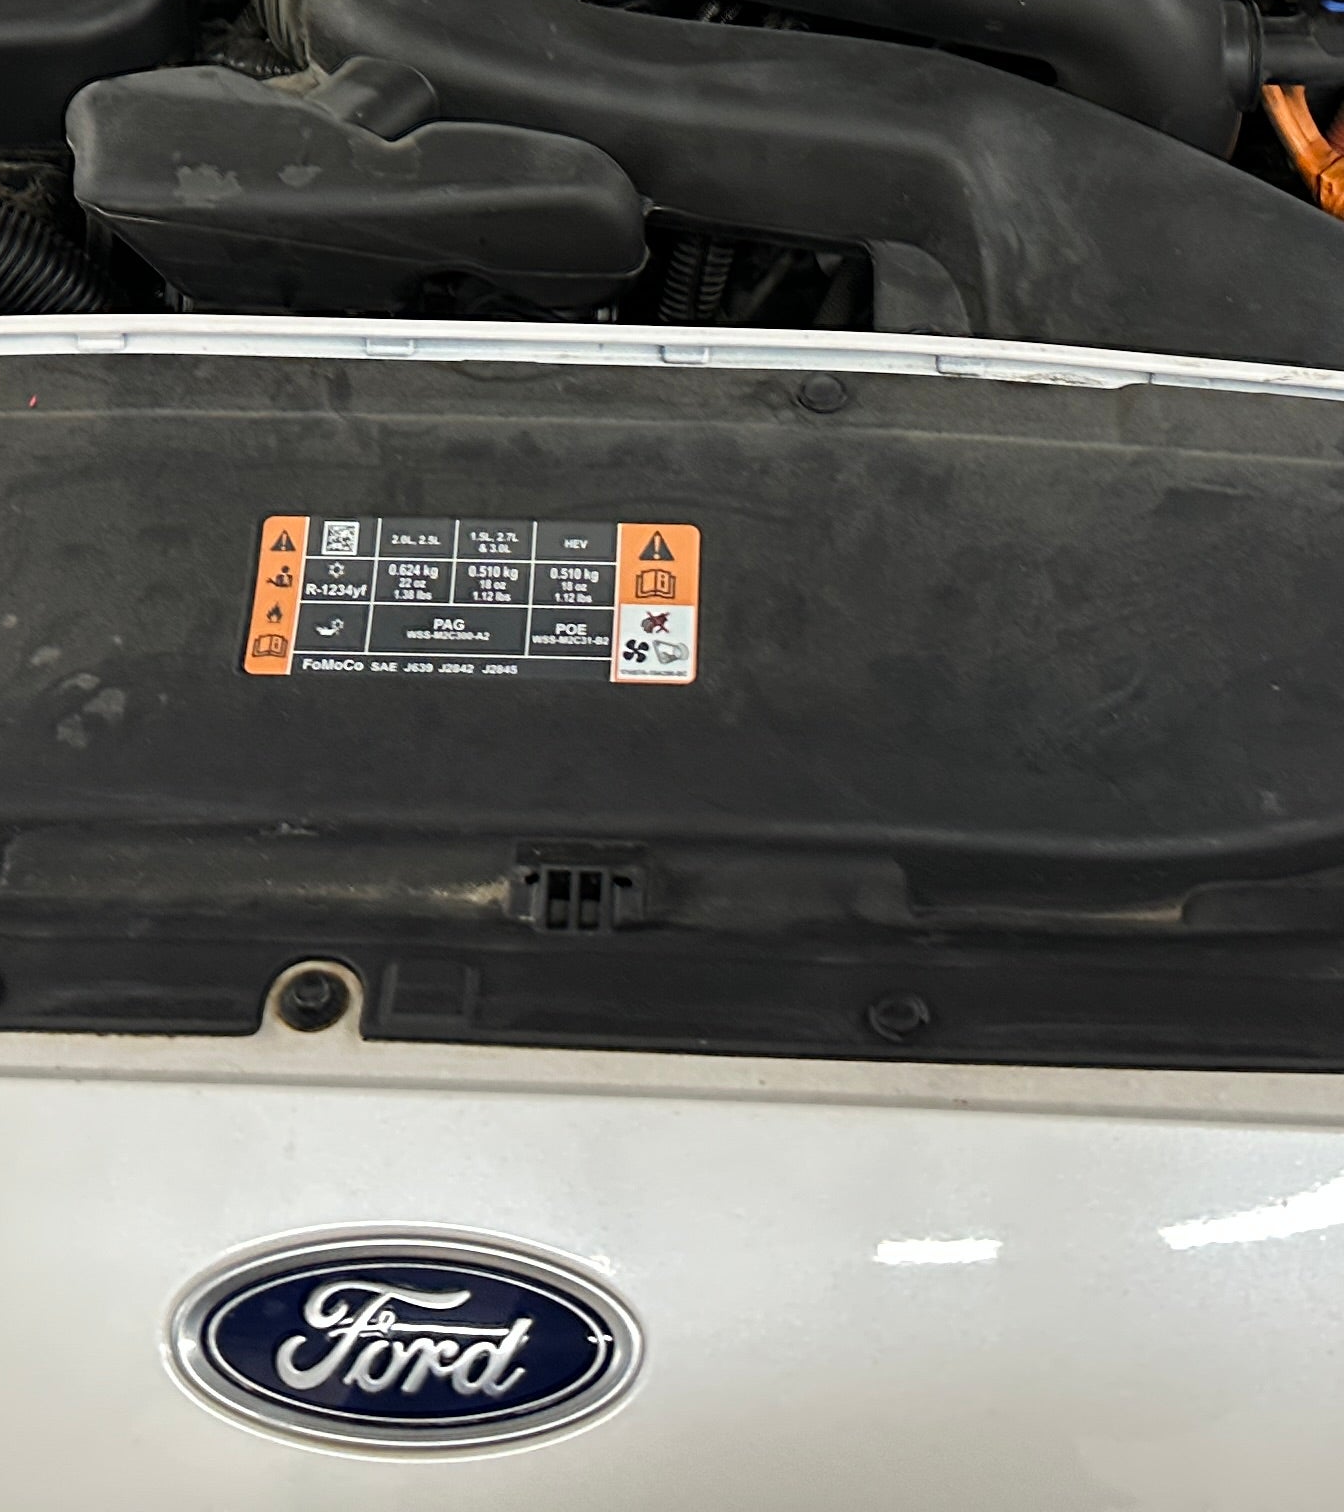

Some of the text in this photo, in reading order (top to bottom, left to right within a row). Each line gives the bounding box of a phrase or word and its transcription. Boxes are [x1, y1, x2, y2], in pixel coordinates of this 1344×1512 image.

[564, 539, 589, 550] HEV
[388, 563, 439, 579] 0.624 kg
[468, 565, 519, 581] 0.510 kg
[549, 567, 600, 583] 0.510 kg
[413, 579, 427, 589] oz
[493, 580, 507, 590] oz
[575, 582, 588, 592] oz
[305, 583, 368, 599] R-1234yf
[416, 590, 433, 600] lbs
[472, 591, 512, 602] 1.12 lbs
[555, 593, 593, 603] 1.12 lbs
[433, 618, 466, 631] PAG
[555, 623, 588, 635] POE
[302, 658, 365, 672] FoMoCo
[370, 661, 399, 673] SAE
[403, 662, 434, 673] J639
[275, 1279, 535, 1397] Ford
